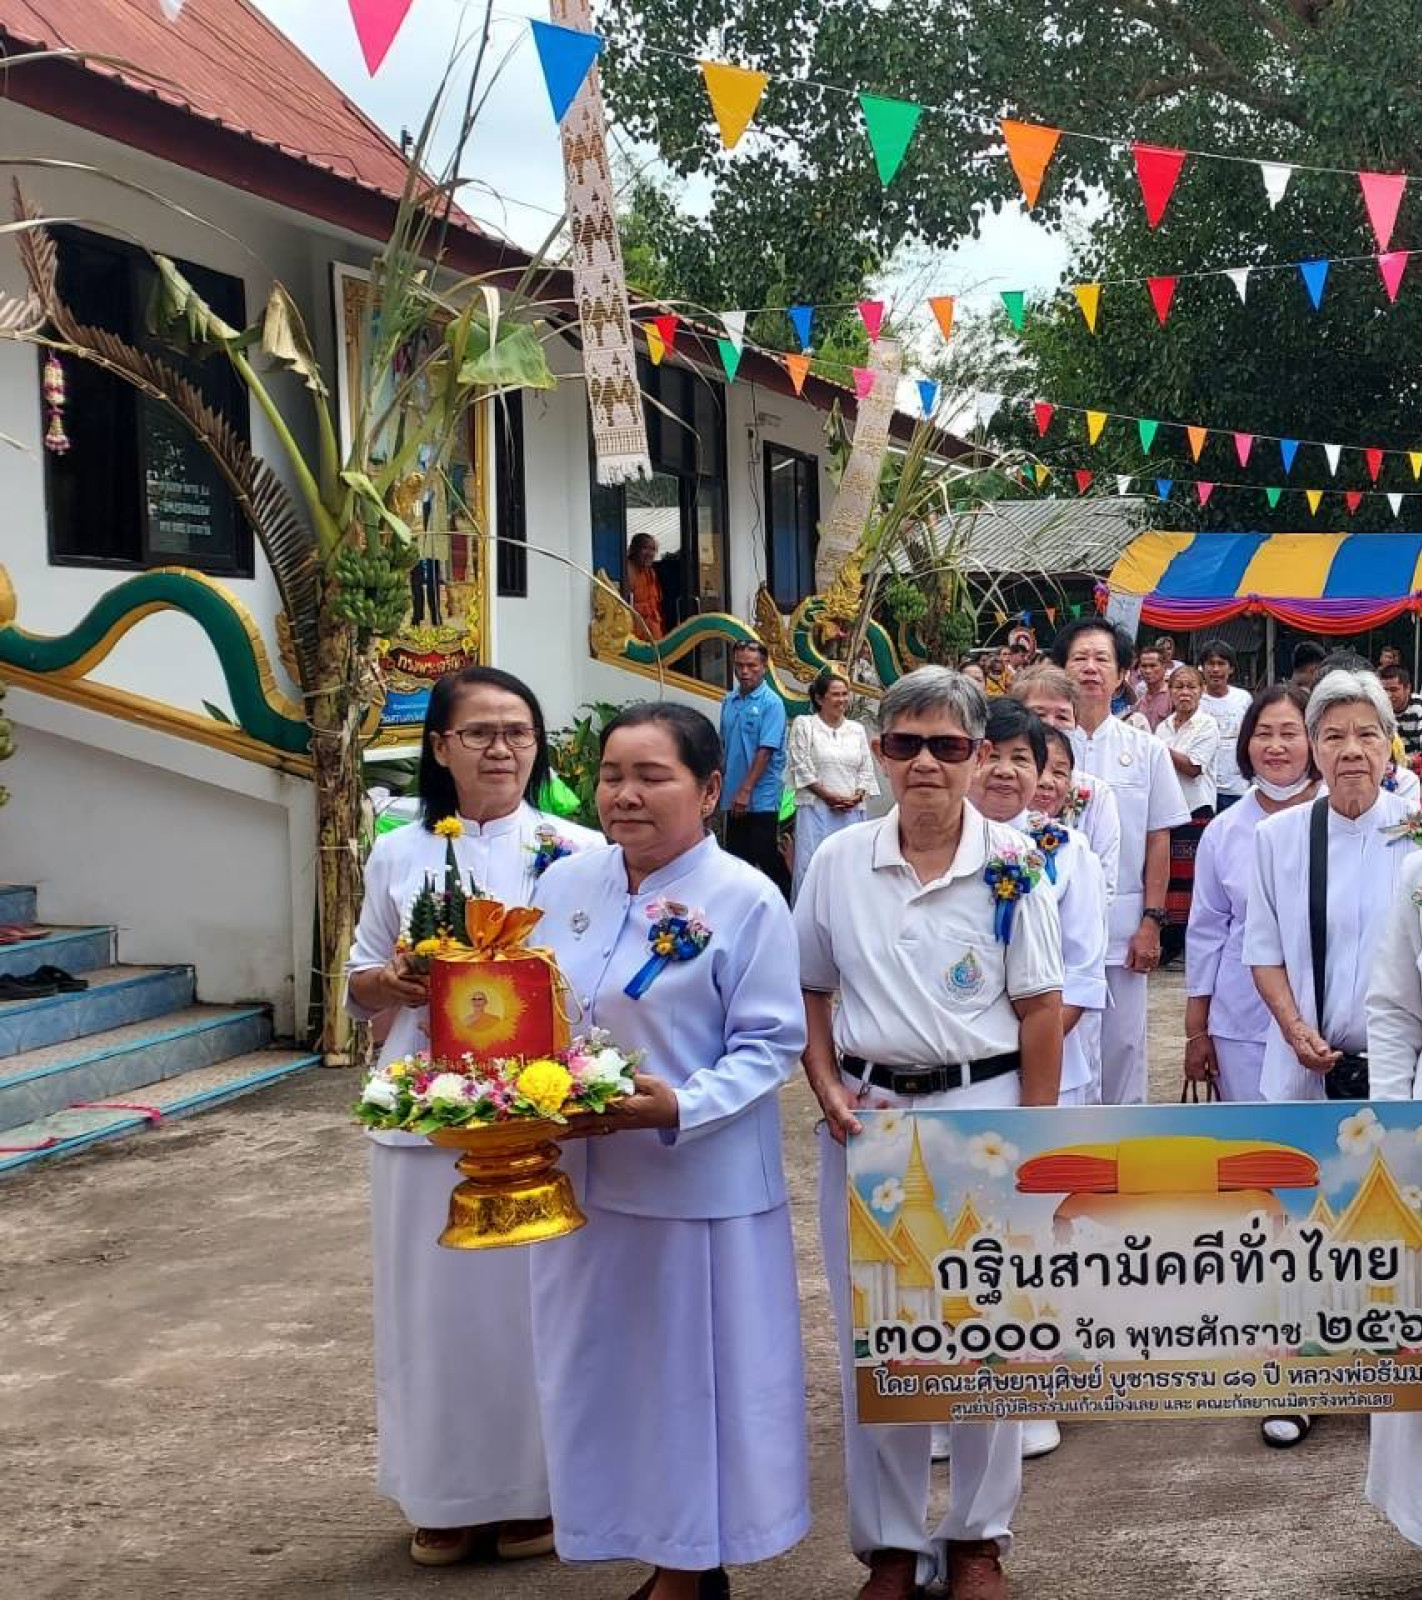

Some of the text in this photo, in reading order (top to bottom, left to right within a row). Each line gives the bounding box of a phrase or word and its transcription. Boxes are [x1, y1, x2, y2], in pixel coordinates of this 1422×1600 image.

[937, 1216, 1399, 1305] กฐินสามัคคีทั่วไทย
[874, 1322, 1061, 1359] ๓๐,๐๐๐
[1074, 1317, 1116, 1350] วัด
[1126, 1314, 1301, 1360] พุทธศักราช
[874, 1369, 918, 1394] โดย
[925, 1362, 1103, 1397] คณะศิษยานุศิษย์
[1109, 1370, 1216, 1397] บูชาธรรม
[1263, 1361, 1281, 1386] ปี
[1164, 1399, 1192, 1411] และ
